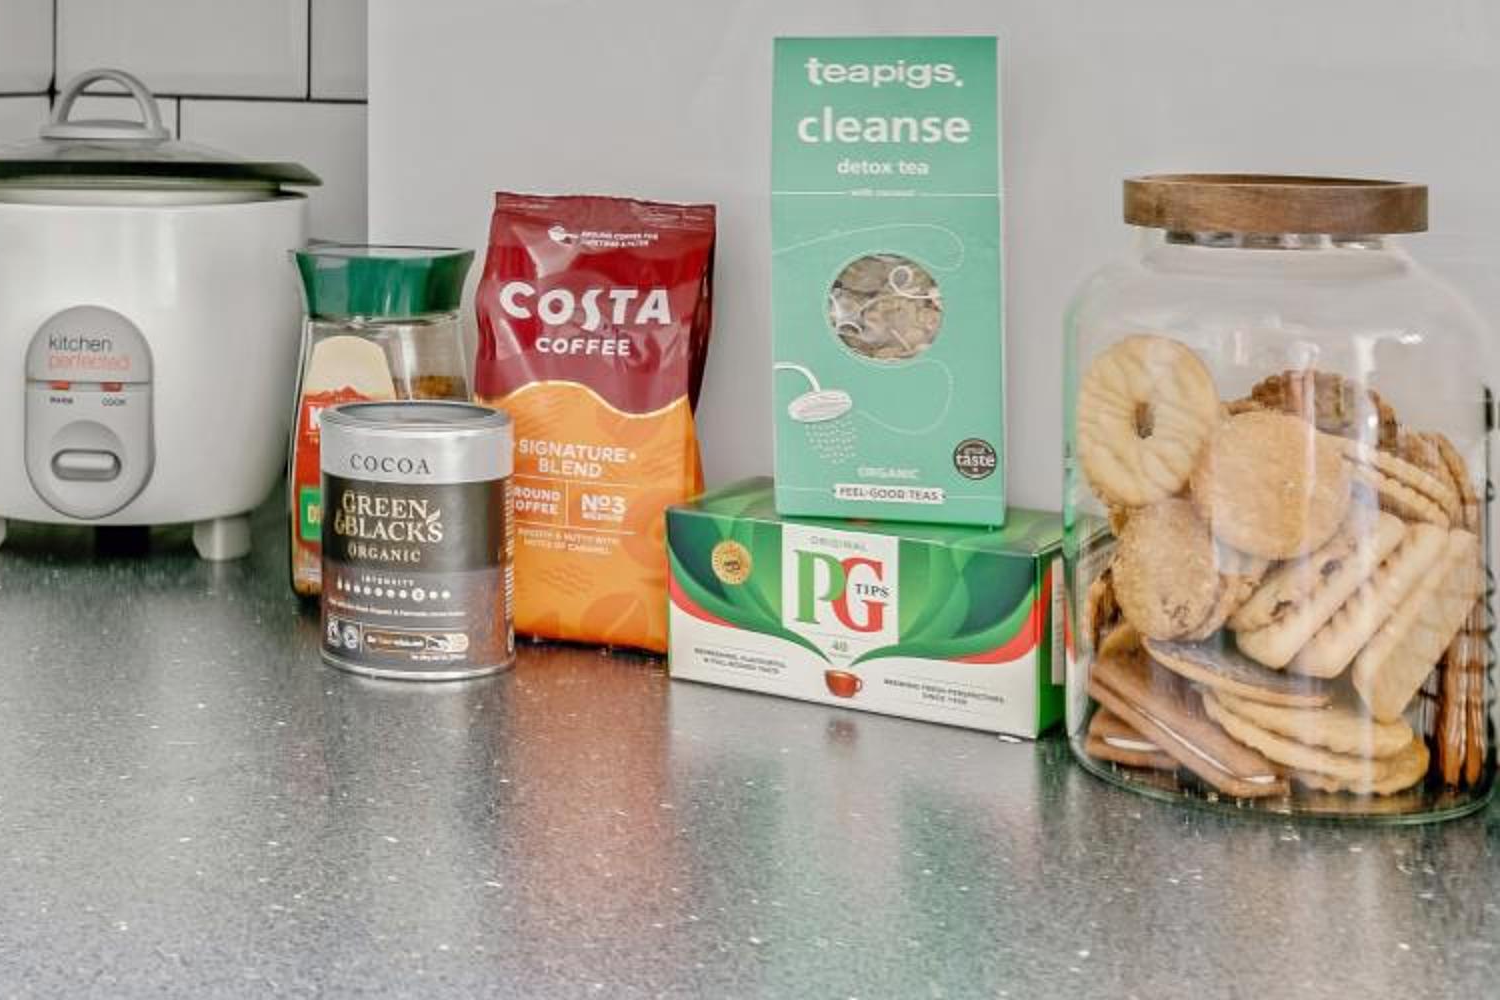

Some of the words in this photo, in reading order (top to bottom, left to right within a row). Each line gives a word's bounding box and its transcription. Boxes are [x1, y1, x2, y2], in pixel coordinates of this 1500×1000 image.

[797, 106, 972, 143] cleanse
[837, 159, 892, 174] detox
[899, 161, 930, 175] tea
[500, 281, 673, 332] COSTA
[49, 334, 112, 352] kitchen
[535, 337, 631, 357] COFFEE
[519, 439, 629, 463] SIGNATURE
[956, 454, 995, 467] taste
[350, 453, 432, 475] COCOA
[539, 458, 603, 478] BLEND
[857, 467, 920, 479] ORGANIC
[513, 486, 561, 502] ROUND
[909, 490, 939, 501] TEAS
[343, 490, 428, 519] GREEN
[515, 499, 559, 515] OFFEE
[348, 542, 421, 562] ORGANIC
[362, 574, 415, 587] INTENSITY
[793, 549, 889, 633] PG
[855, 583, 891, 598] TIPS
